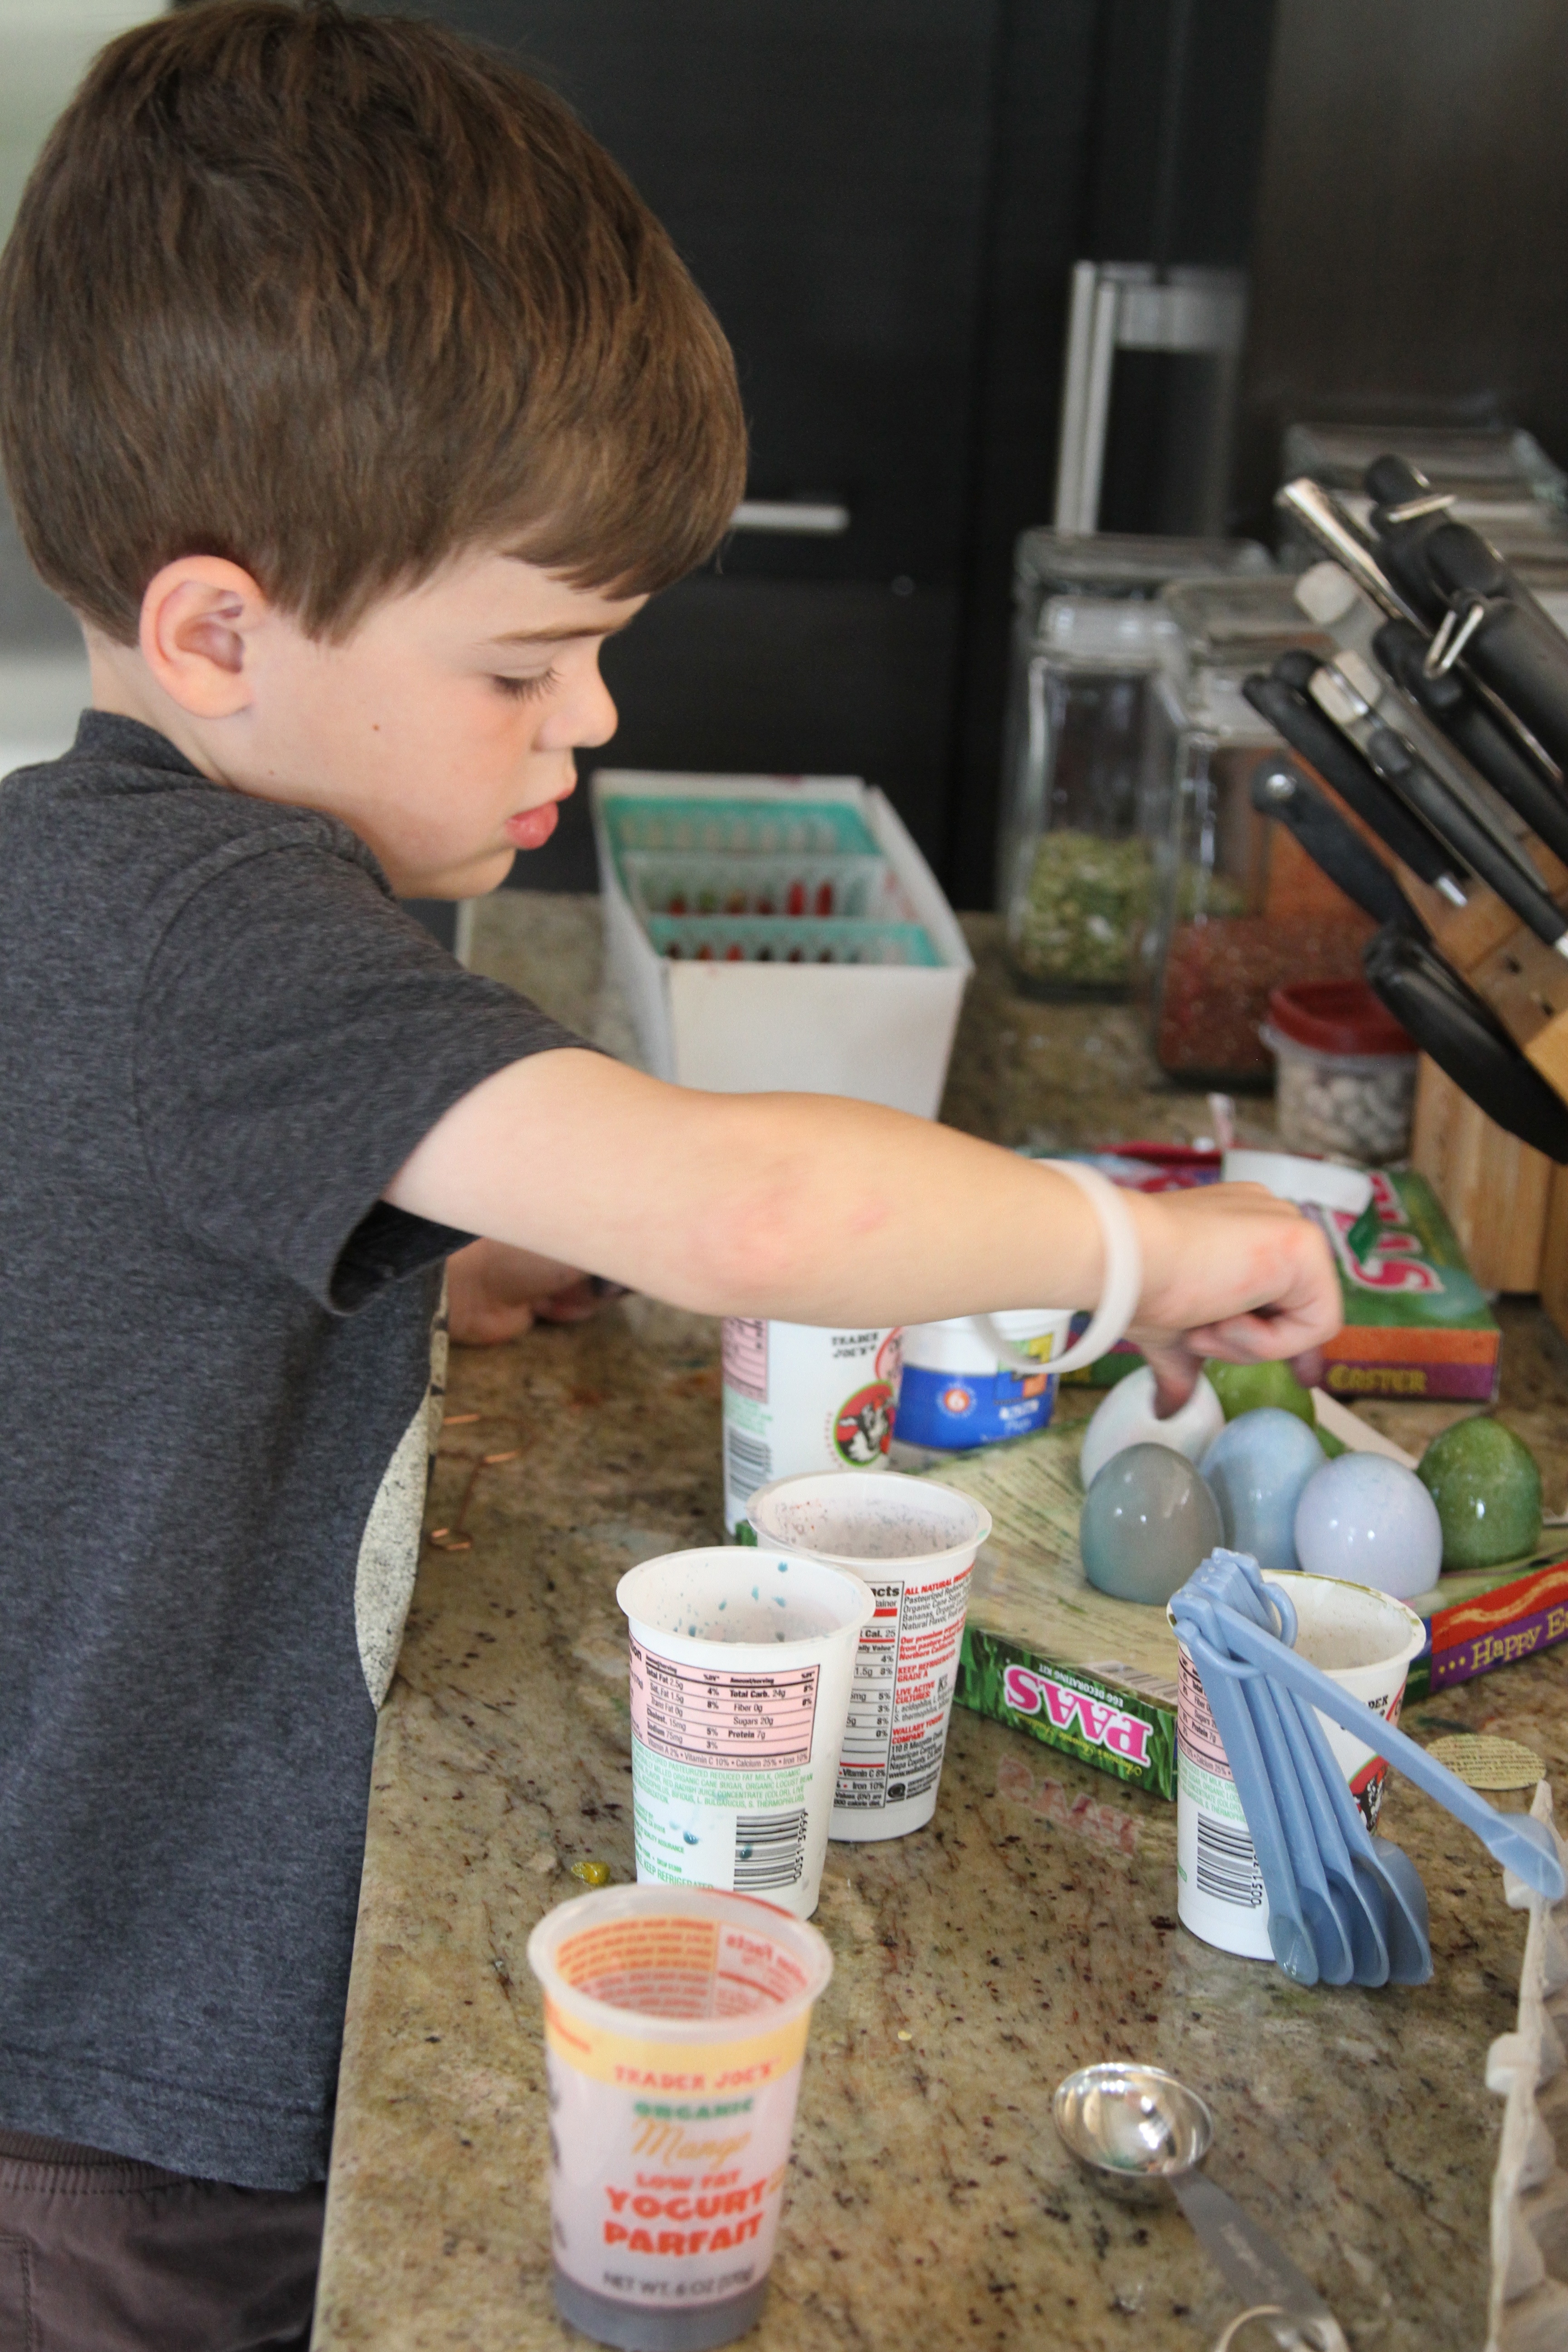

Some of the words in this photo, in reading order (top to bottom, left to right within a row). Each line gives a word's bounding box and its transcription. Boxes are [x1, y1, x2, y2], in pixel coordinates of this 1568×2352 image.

[832, 1332, 878, 1346] TRADER
[904, 1587, 919, 1596] ALL
[921, 1578, 952, 1593] NATURAL
[904, 1589, 944, 1604] Pasteurized
[903, 1602, 931, 1614] Organic
[865, 1629, 882, 1637] Cal.
[902, 1619, 928, 1631] Natural
[901, 1636, 914, 1644] Our
[916, 1629, 943, 1644] premium
[899, 1650, 930, 1661] Northern
[855, 1667, 873, 1677] 1.5g
[897, 1672, 921, 1683] GRADE
[923, 1669, 928, 1678] A
[898, 1665, 917, 1674] KEEP
[1039, 1663, 1053, 1677] KIT
[646, 1666, 658, 1679] Total
[659, 1673, 669, 1684] Fat
[670, 1677, 684, 1690] 2.5g
[707, 1686, 720, 1696] 4%
[896, 1687, 911, 1696] LIVE
[913, 1680, 935, 1692] ACTIVE
[1054, 1670, 1105, 1700] DECORATING
[650, 1682, 660, 1695] Sat.
[661, 1687, 669, 1698] Fat
[671, 1691, 684, 1704] 1.5g
[707, 1700, 719, 1710] 8%
[730, 1689, 749, 1698] Total
[750, 1690, 770, 1698] Carb.
[772, 1689, 786, 1699] 24g
[803, 1685, 813, 1693] 8%
[895, 1691, 931, 1705] CULTURES
[651, 1695, 664, 1709] Trans
[665, 1702, 674, 1714] Fat
[675, 1706, 683, 1718] 0g
[734, 1704, 751, 1712] Fiber
[753, 1703, 763, 1713] 0g
[802, 1698, 812, 1706] 0%
[1106, 1693, 1124, 1709] EGG
[647, 1707, 667, 1725] Cholest.
[669, 1718, 686, 1732] 15mg
[706, 1726, 718, 1737] 5%
[733, 1717, 759, 1727] Sugars
[760, 1717, 774, 1726] 20g
[1004, 1666, 1152, 1767] PAAS
[1194, 1709, 1210, 1725] Sugars
[647, 1719, 665, 1737] Sodium
[666, 1730, 683, 1745] 75mg
[706, 1740, 718, 1749] 3%
[728, 1730, 755, 1739] Protein
[757, 1730, 766, 1740] 7g
[892, 1722, 925, 1736] WALLABY
[892, 1730, 925, 1744] COMPANY
[1191, 1721, 1209, 1738] Protein
[1209, 1732, 1216, 1744] 7g
[647, 1738, 664, 1753] Vitamin
[665, 1745, 670, 1754] A
[670, 1748, 679, 1758] 2%
[684, 1751, 707, 1764] Vitamin
[708, 1757, 714, 1765] C
[715, 1757, 730, 1767] 10%
[735, 1759, 761, 1768] Calcium
[763, 1758, 777, 1767] 25%
[783, 1756, 794, 1765] Iron
[796, 1753, 808, 1762] 10%
[891, 1750, 919, 1762] American
[668, 1760, 709, 1777] PASTEURIZED
[710, 1770, 740, 1781] REDUCED
[742, 1773, 753, 1781] FAT
[774, 1768, 801, 1780] ORGANIC
[843, 1769, 867, 1777] Vitamin
[890, 1761, 906, 1771] Napa
[1196, 1754, 1214, 1770] Calcium
[1215, 1764, 1227, 1776] 25%
[662, 1777, 674, 1788] RED
[674, 1783, 697, 1793] RADISH
[699, 1788, 716, 1797] JUICE
[717, 1790, 762, 1799] CONCENTRATE
[673, 1772, 699, 1785] ORGANIC
[701, 1779, 717, 1788] CANE
[745, 1780, 774, 1790] ORGANIC
[657, 1838, 685, 1854] ASSURANCE
[643, 1859, 656, 1876] KEEP
[615, 2064, 706, 2090] TRADER
[633, 2097, 753, 2120] ORGANIC
[632, 2117, 751, 2171] Mango
[636, 2171, 694, 2190] LOW
[701, 2167, 741, 2189] FAT
[604, 2178, 767, 2221] YOGURT
[603, 2211, 764, 2258] PARFAIT
[603, 2270, 634, 2290] NET
[691, 2277, 715, 2295] OZ
